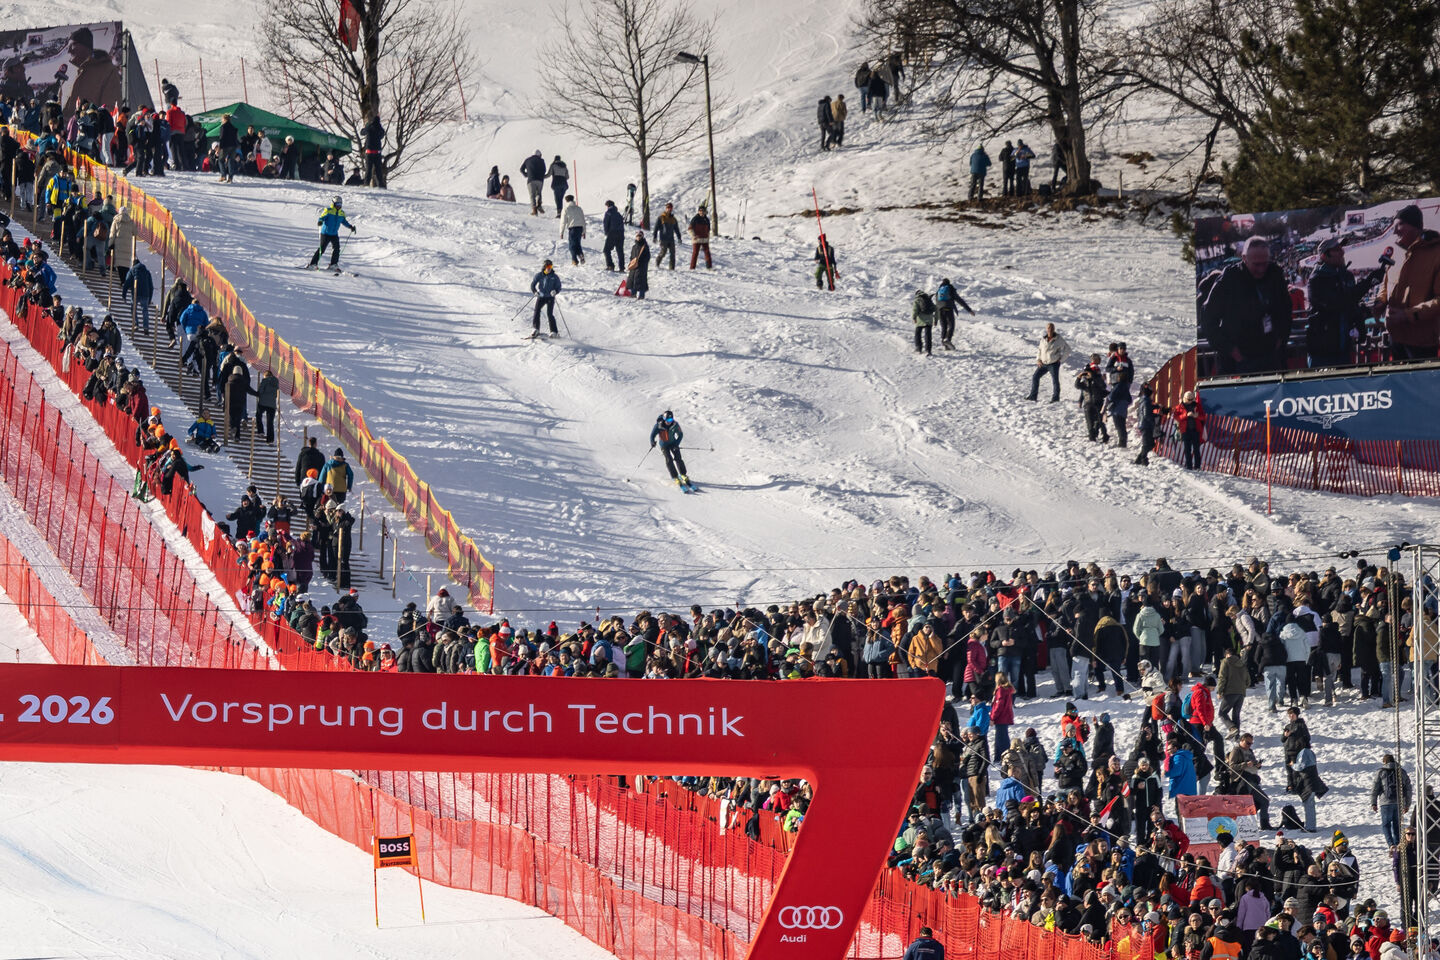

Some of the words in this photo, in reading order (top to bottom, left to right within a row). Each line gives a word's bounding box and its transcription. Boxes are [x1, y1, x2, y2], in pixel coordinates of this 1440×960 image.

[1263, 390, 1393, 419] LONGINES
[17, 694, 115, 725] 2026
[160, 693, 404, 736] Vorsprung
[421, 701, 552, 733] durch
[568, 704, 745, 737] Technik
[380, 842, 409, 853] BOSS
[780, 934, 807, 943] Audi
